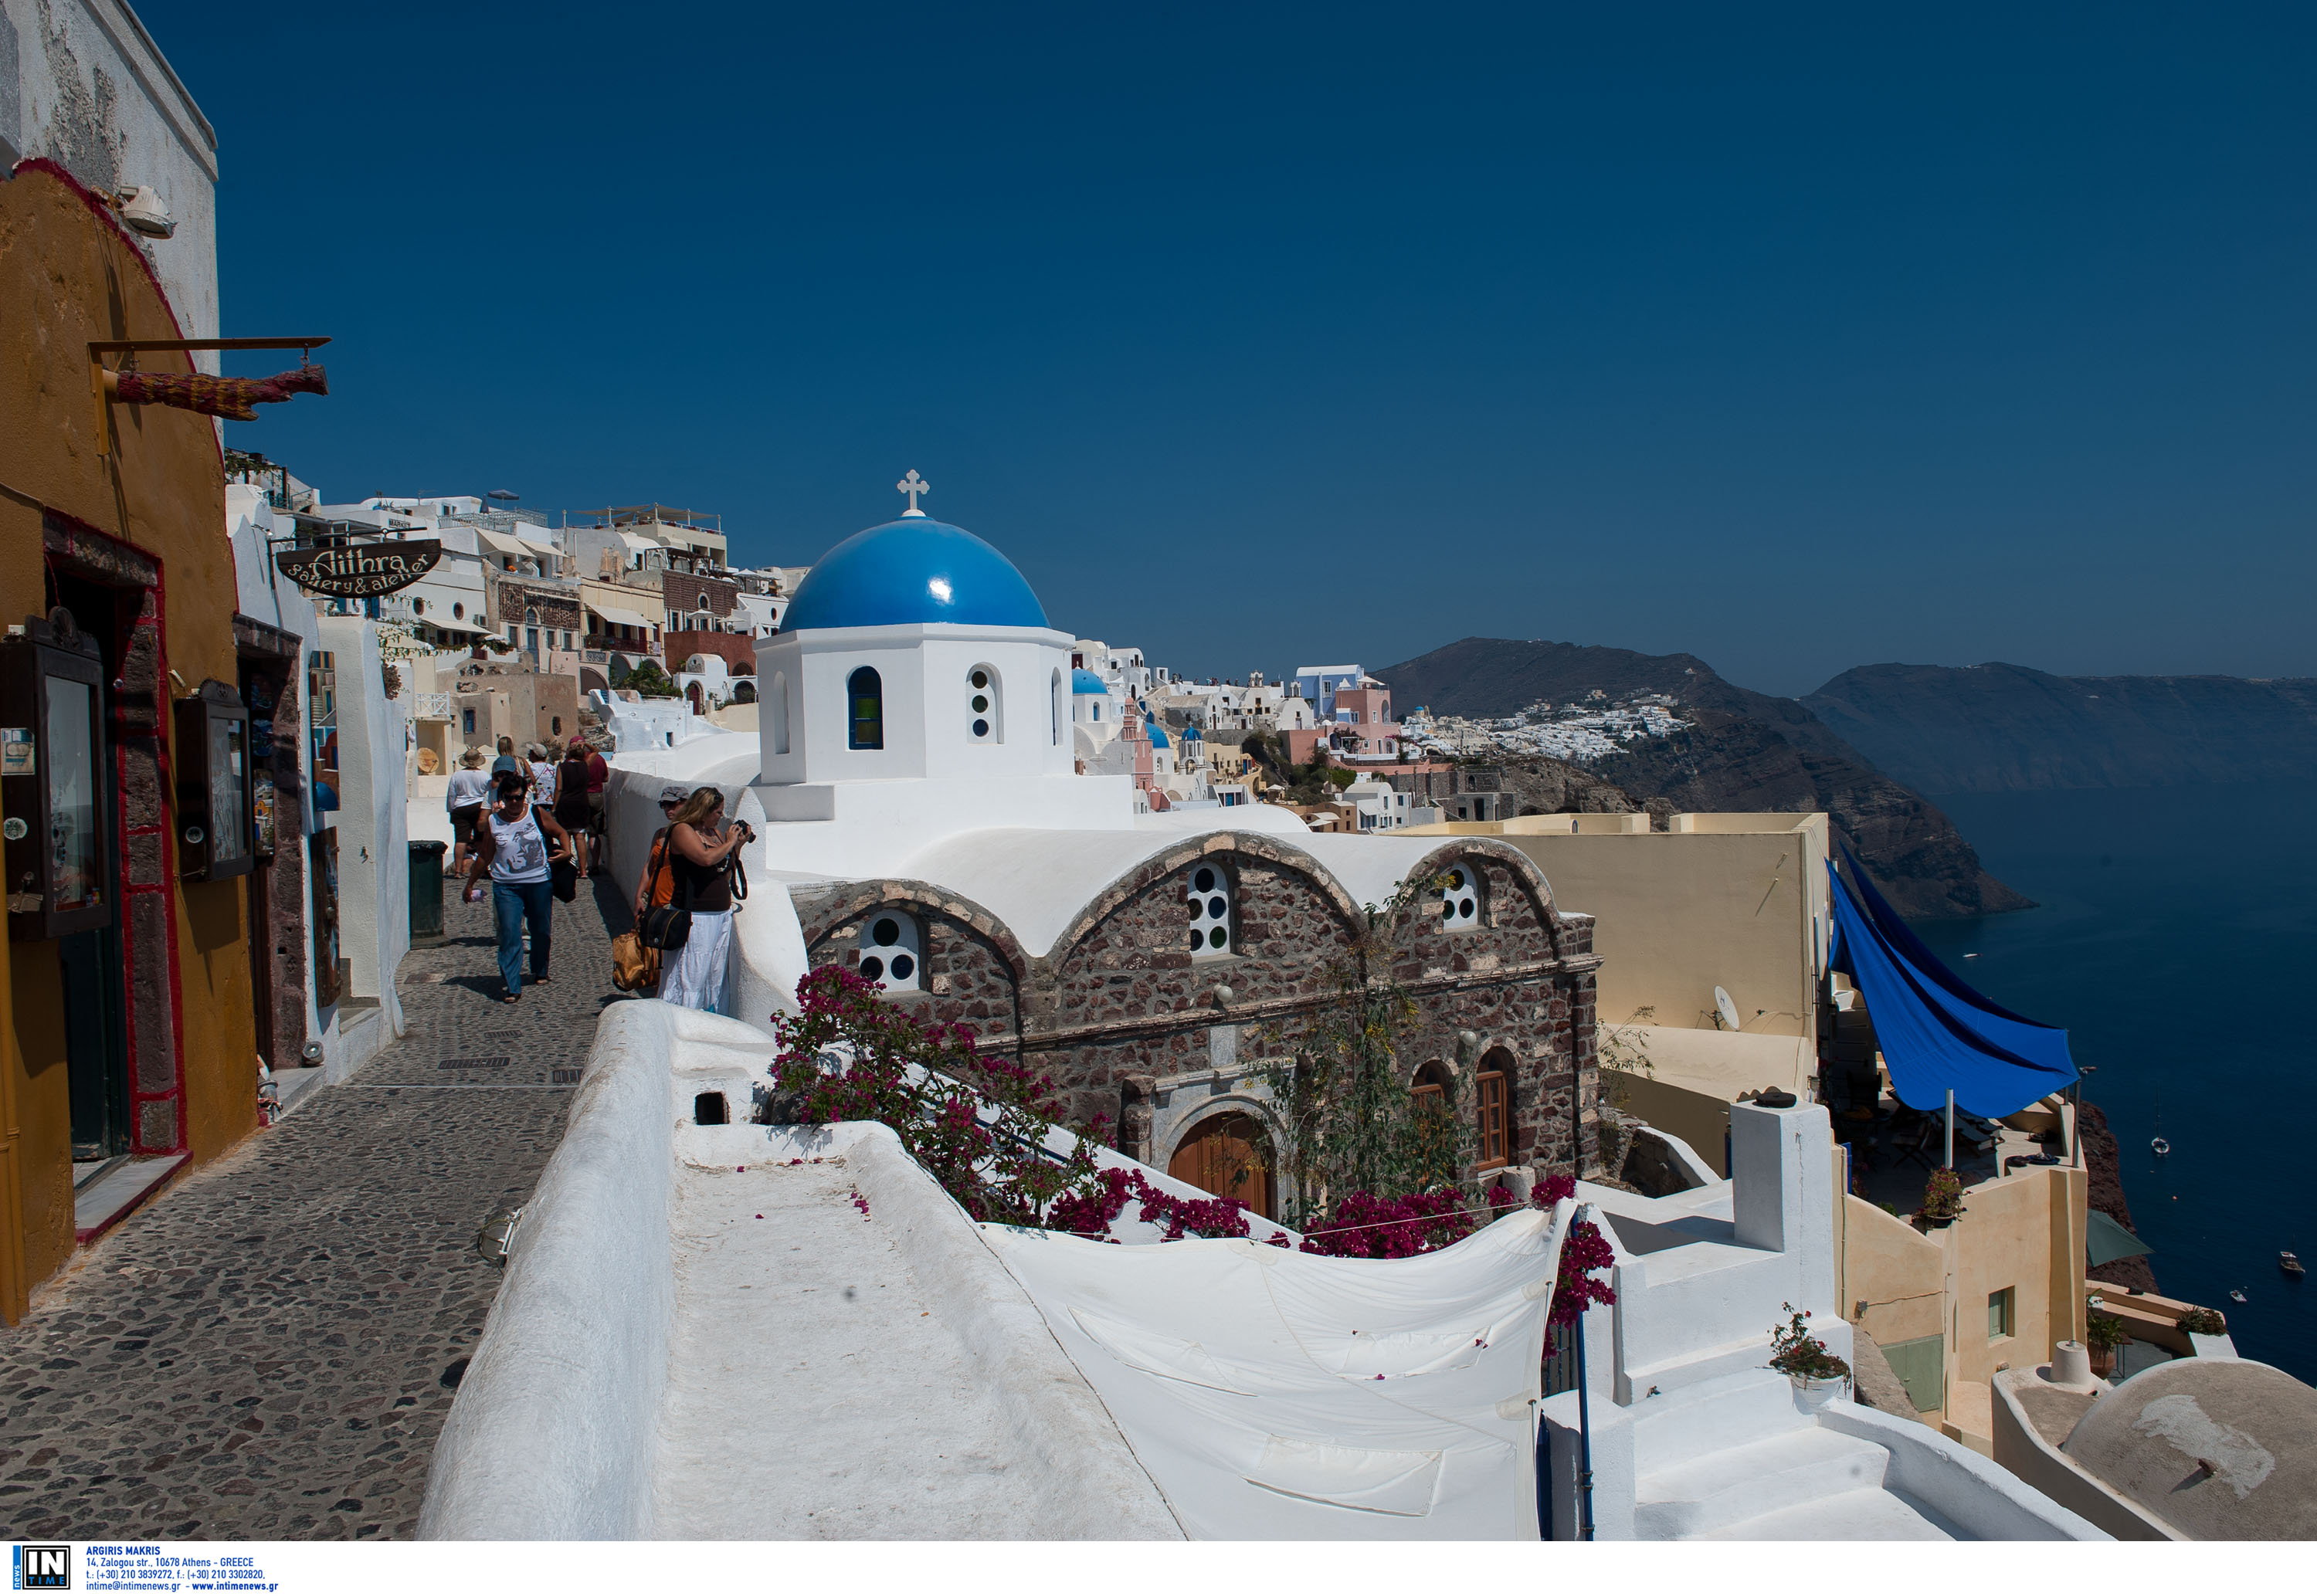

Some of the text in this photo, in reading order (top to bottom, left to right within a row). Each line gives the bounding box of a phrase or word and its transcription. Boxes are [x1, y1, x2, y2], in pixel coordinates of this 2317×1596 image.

[309, 547, 405, 578] Aithra
[288, 564, 352, 594] gallery
[355, 578, 371, 595] &
